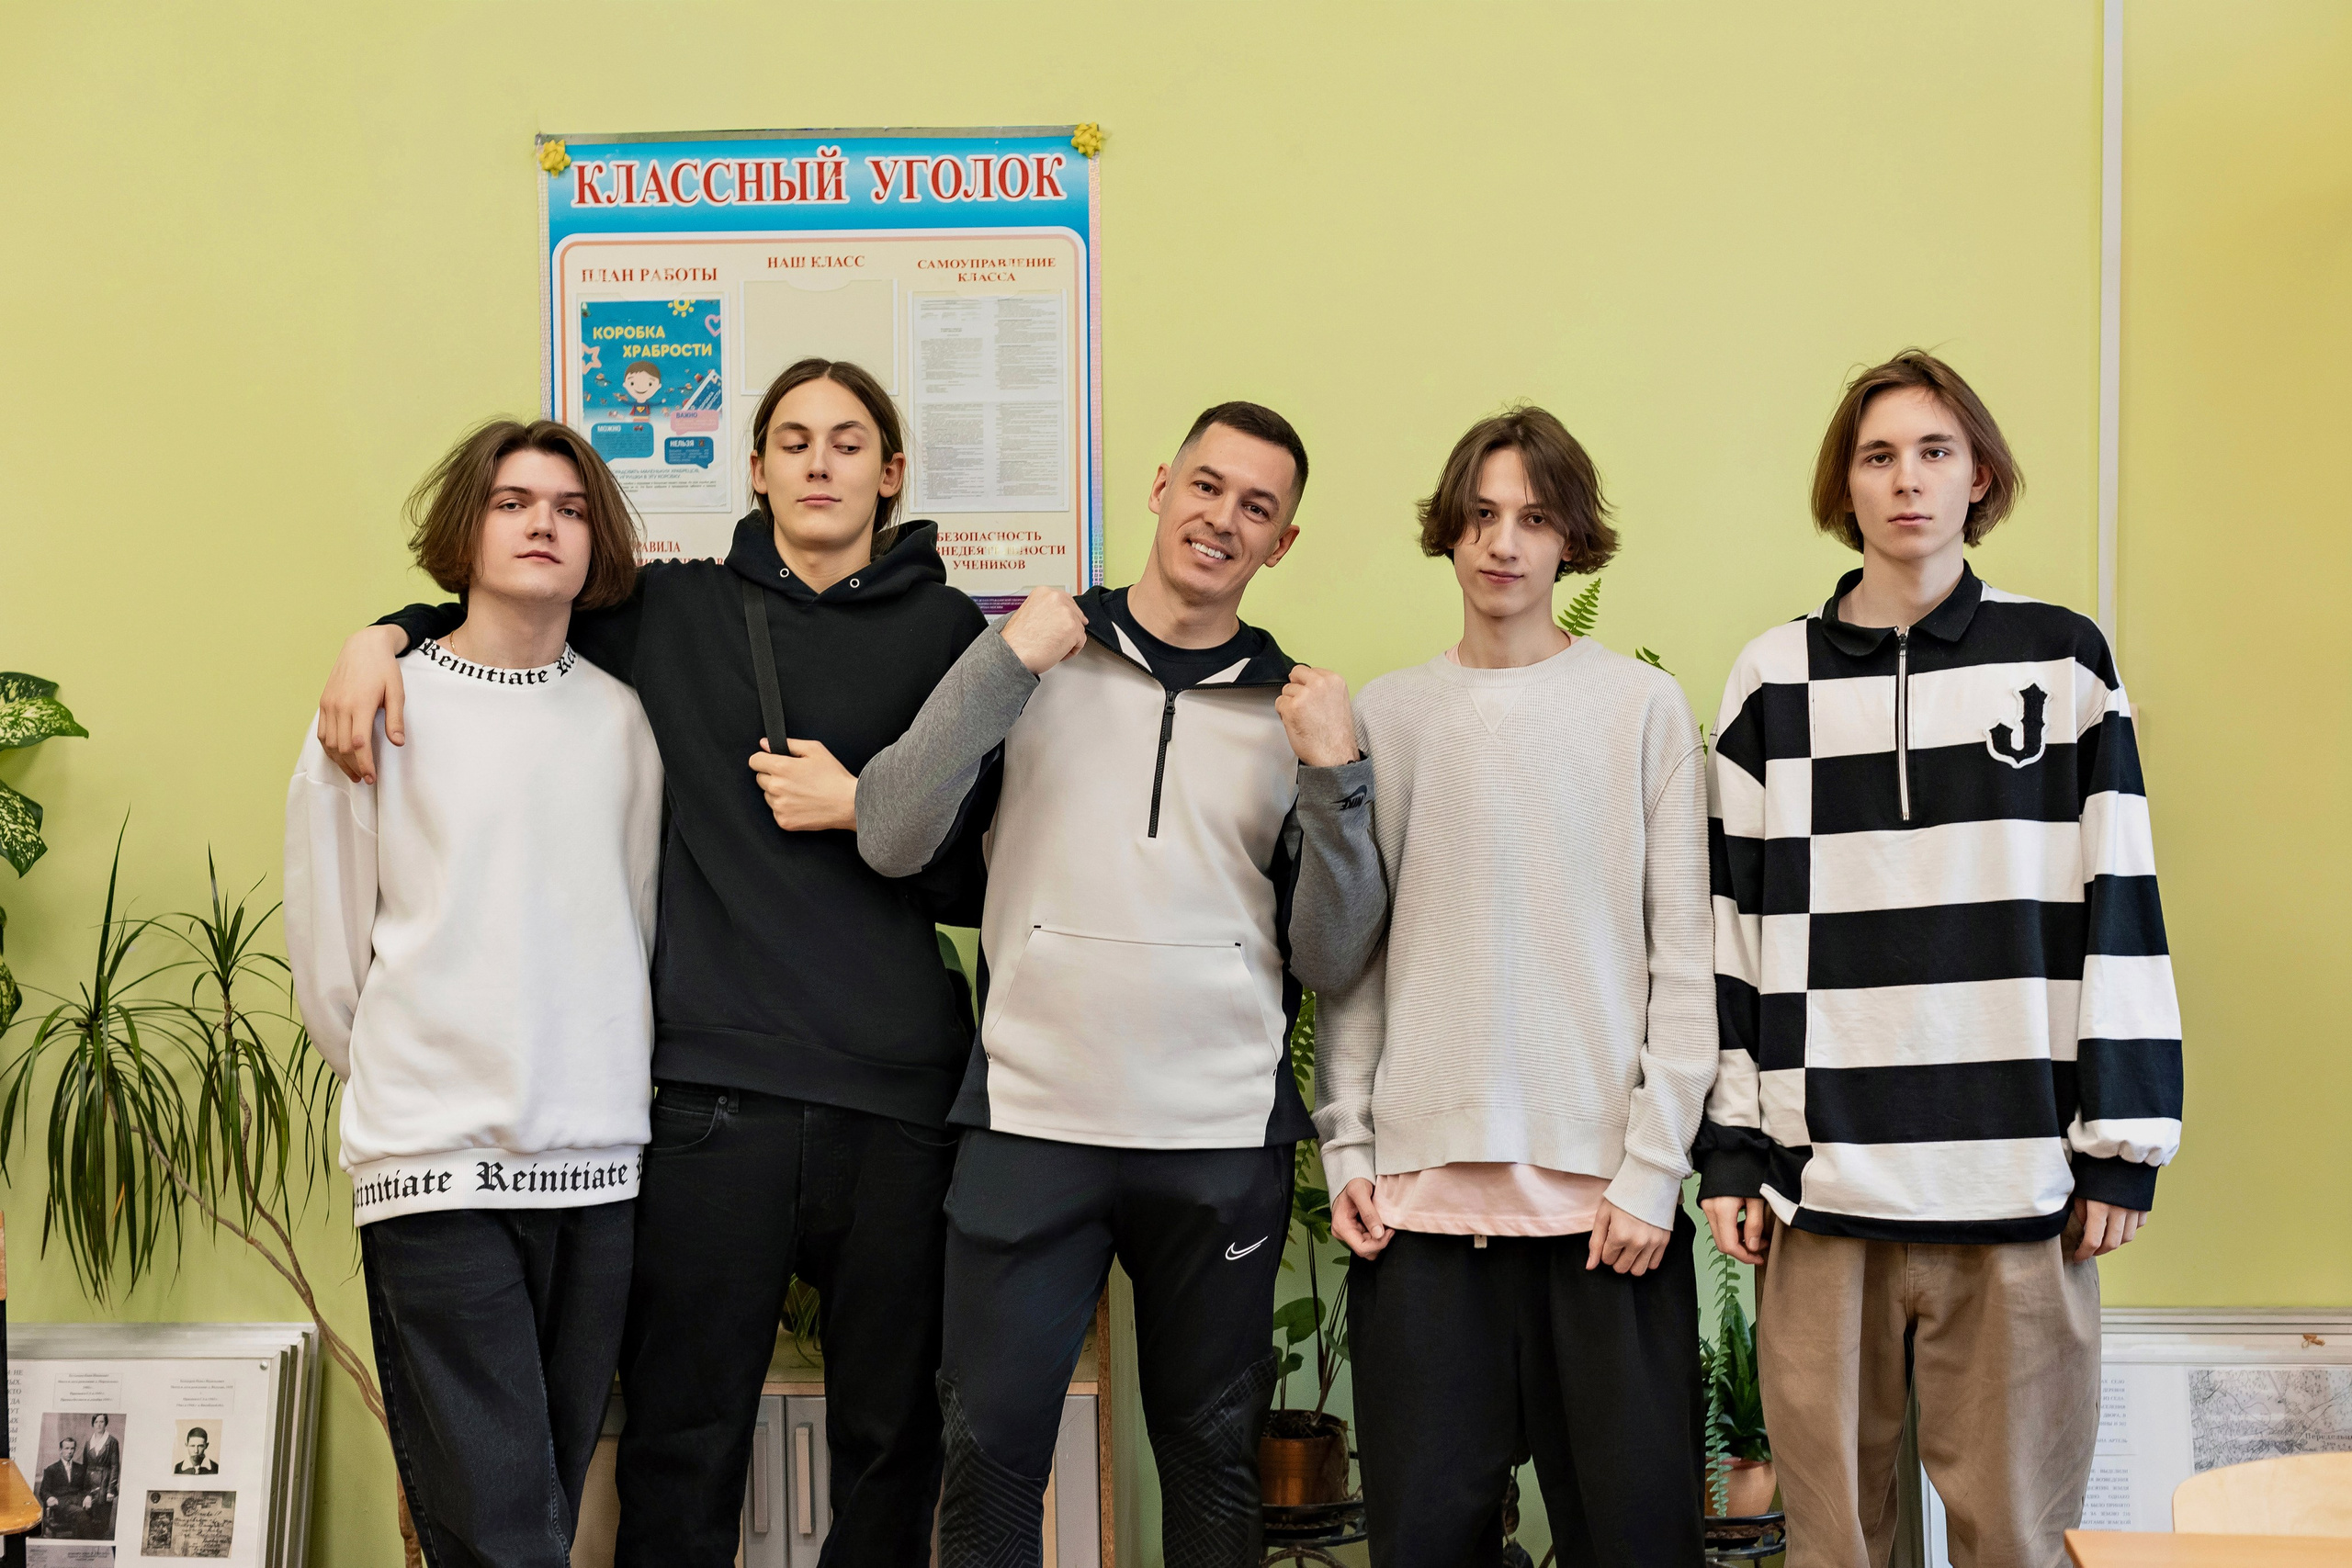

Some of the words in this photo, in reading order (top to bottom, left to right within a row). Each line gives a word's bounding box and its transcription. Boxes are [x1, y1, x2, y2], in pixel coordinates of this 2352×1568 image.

[573, 148, 847, 205] КЛАССНЫЙ
[868, 156, 1064, 201] УГОЛОК
[767, 256, 806, 268] НАШ
[811, 254, 865, 268] КЛАСС
[917, 257, 1057, 269] САМОУПРАВЛЕНИЕ
[582, 268, 634, 283] ПЛАН
[639, 266, 718, 283] РАБОТЫ
[957, 272, 1016, 283] КЛАССА
[593, 325, 666, 341] КОРОБКА
[622, 343, 713, 358] ХРАБРОСТИ
[936, 531, 1042, 542] БЕЗОПАСНОСТЬ
[953, 559, 1026, 570] УЧЕНИКОВ
[417, 638, 549, 685] Reinitiate
[1988, 682, 2049, 765] J
[1340, 795, 1364, 811] NIKE
[475, 1161, 628, 1192] Reinitiate
